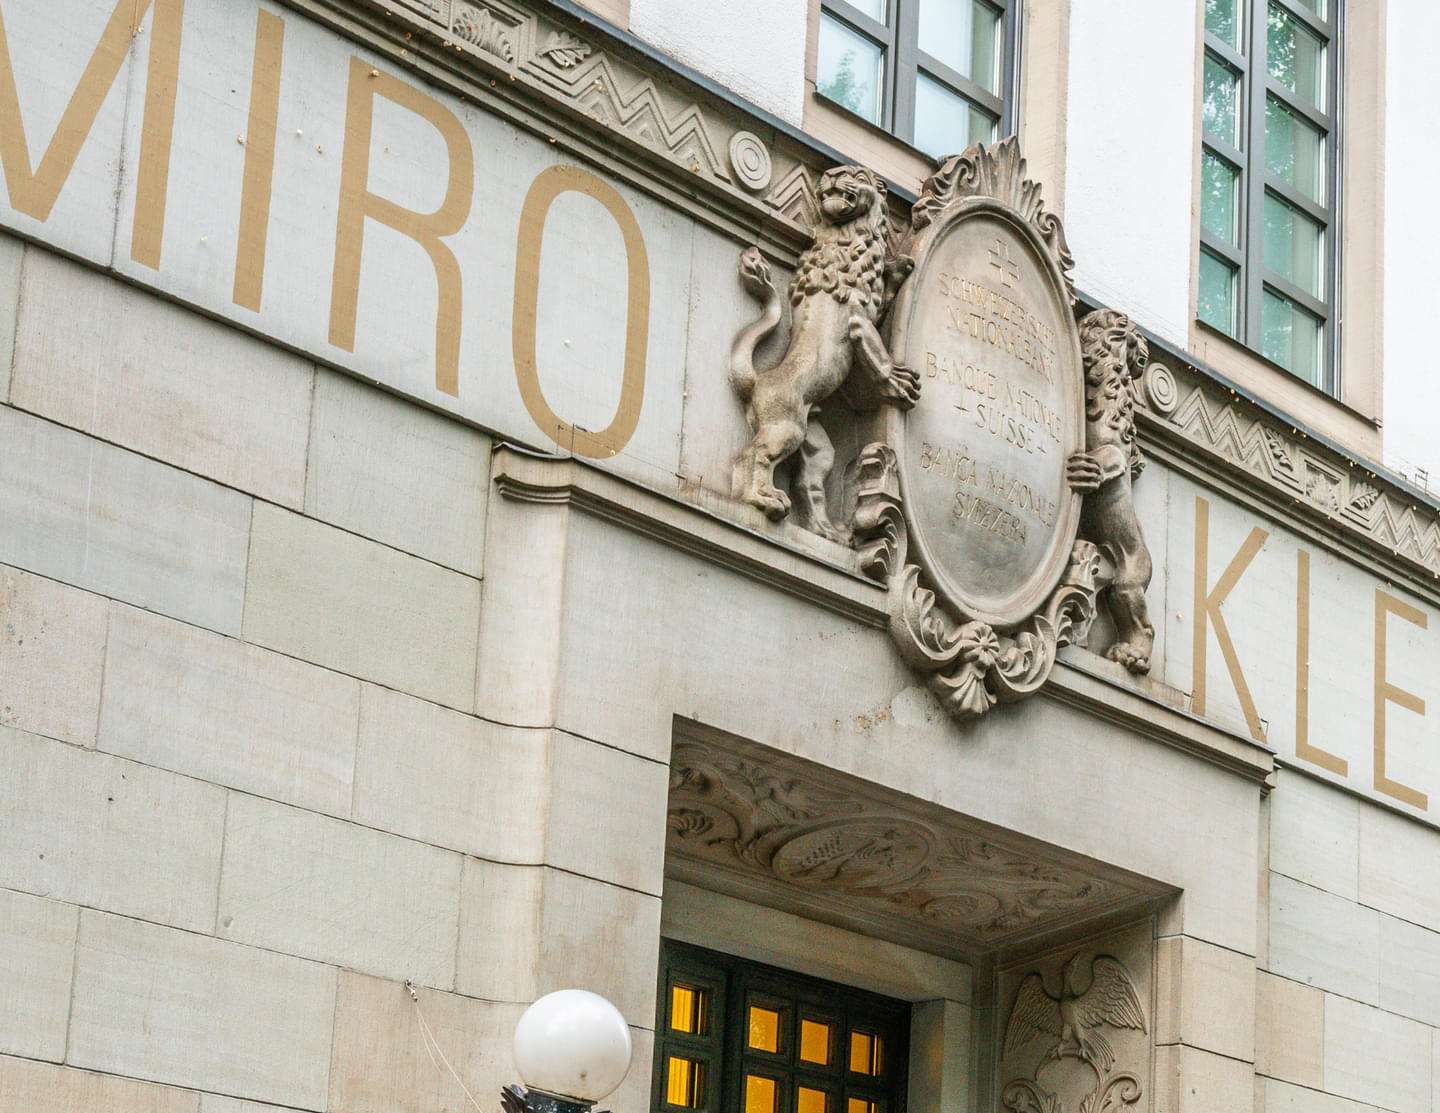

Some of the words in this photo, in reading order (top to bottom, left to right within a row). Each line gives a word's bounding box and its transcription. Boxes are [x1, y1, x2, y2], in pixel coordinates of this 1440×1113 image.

[926, 351, 997, 401] BANQUE
[1005, 381, 1063, 443] NATIONALE
[975, 403, 1035, 455] SUISSE
[919, 442, 978, 488] BANCA
